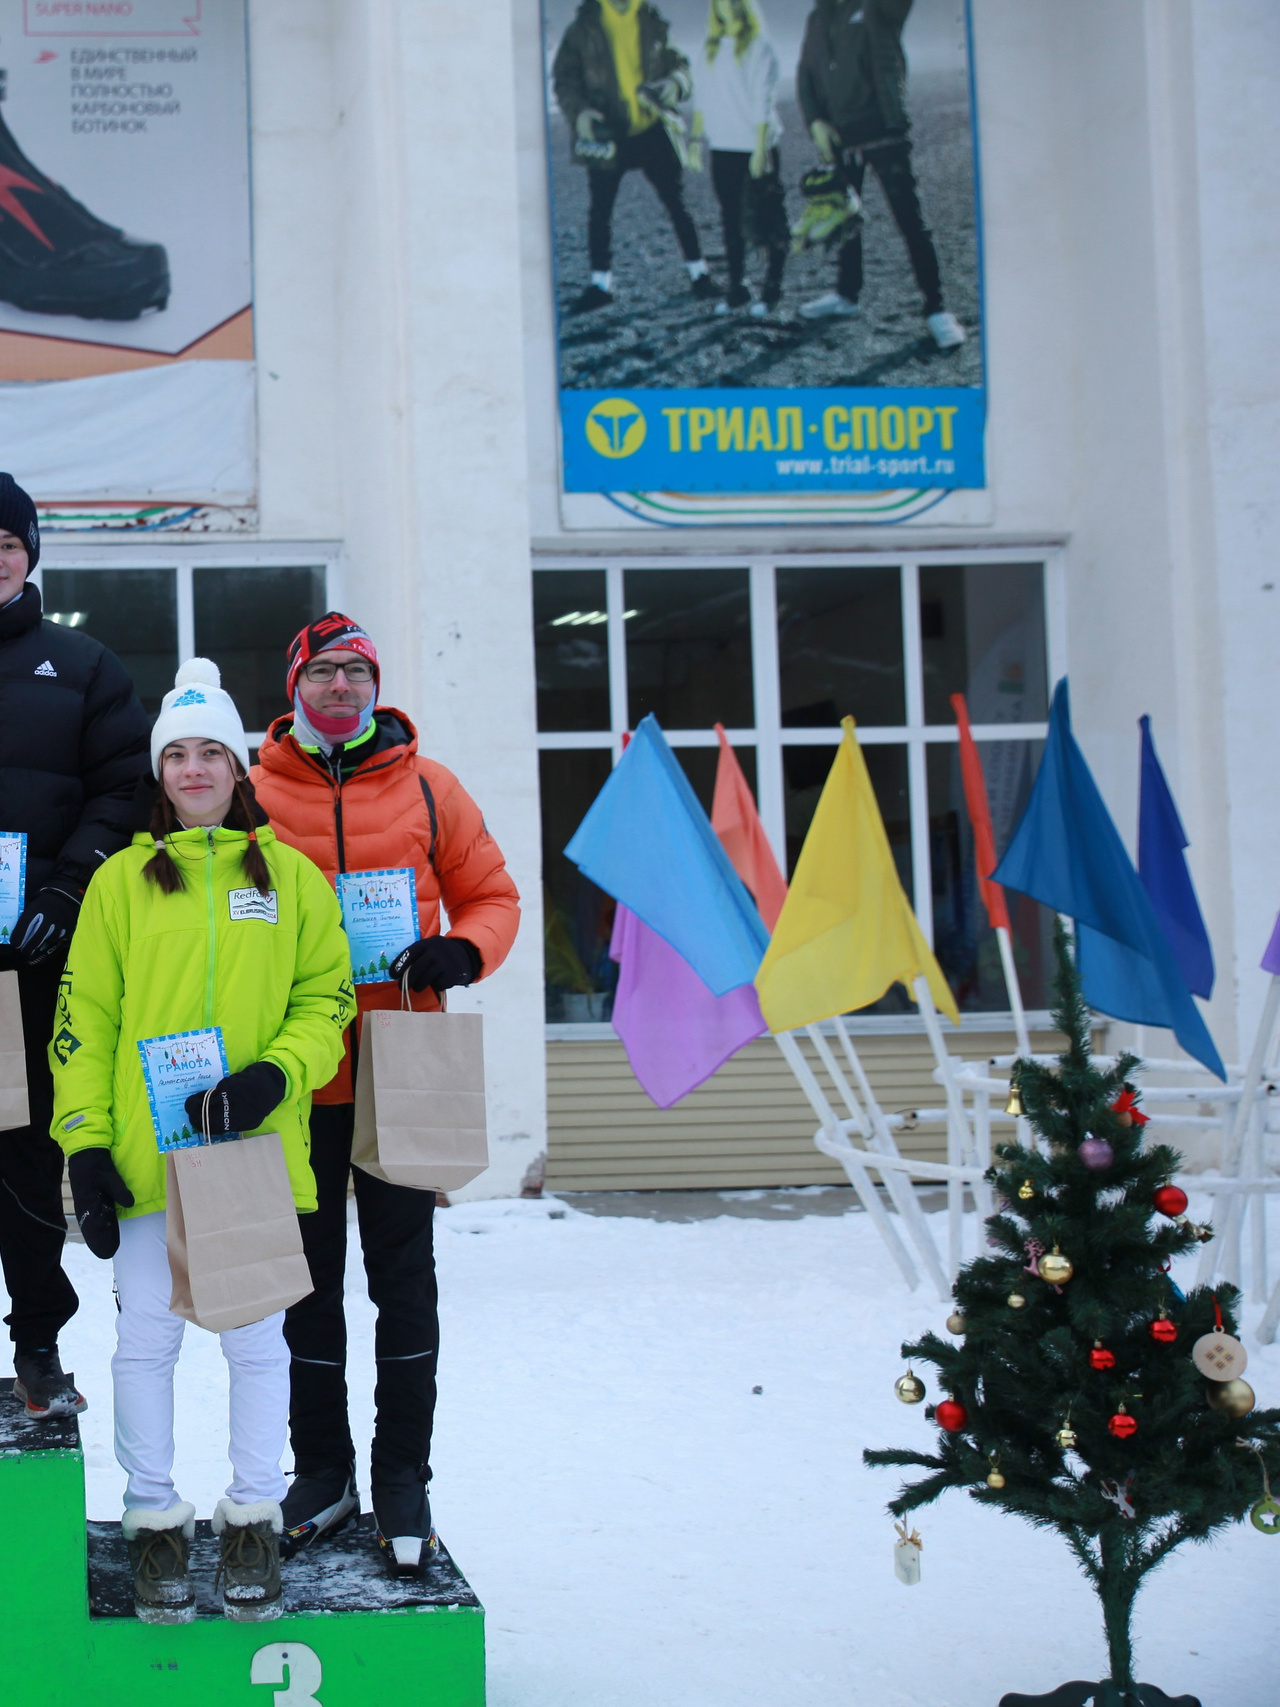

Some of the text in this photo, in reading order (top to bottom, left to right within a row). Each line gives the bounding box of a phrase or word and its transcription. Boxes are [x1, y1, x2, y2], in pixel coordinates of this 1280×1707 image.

[35, 2, 133, 16] SUPER NANO
[70, 47, 198, 64] ЕДИНСТВЕННЫЙ
[71, 67, 126, 81] В МИРЕ
[70, 83, 173, 99] ПОЛНОСТЬЮ
[70, 100, 181, 117] КАРБОНОВЫЙ
[70, 119, 148, 134] БОТИНОК
[776, 455, 955, 478] www.trial-sport.ru
[34, 669, 58, 678] adidas
[351, 898, 402, 911] ГРАМОТА
[158, 1058, 211, 1074] ГРАМОТА
[221, 1091, 230, 1131] NORDSKI
[250, 1642, 322, 1707] 3
